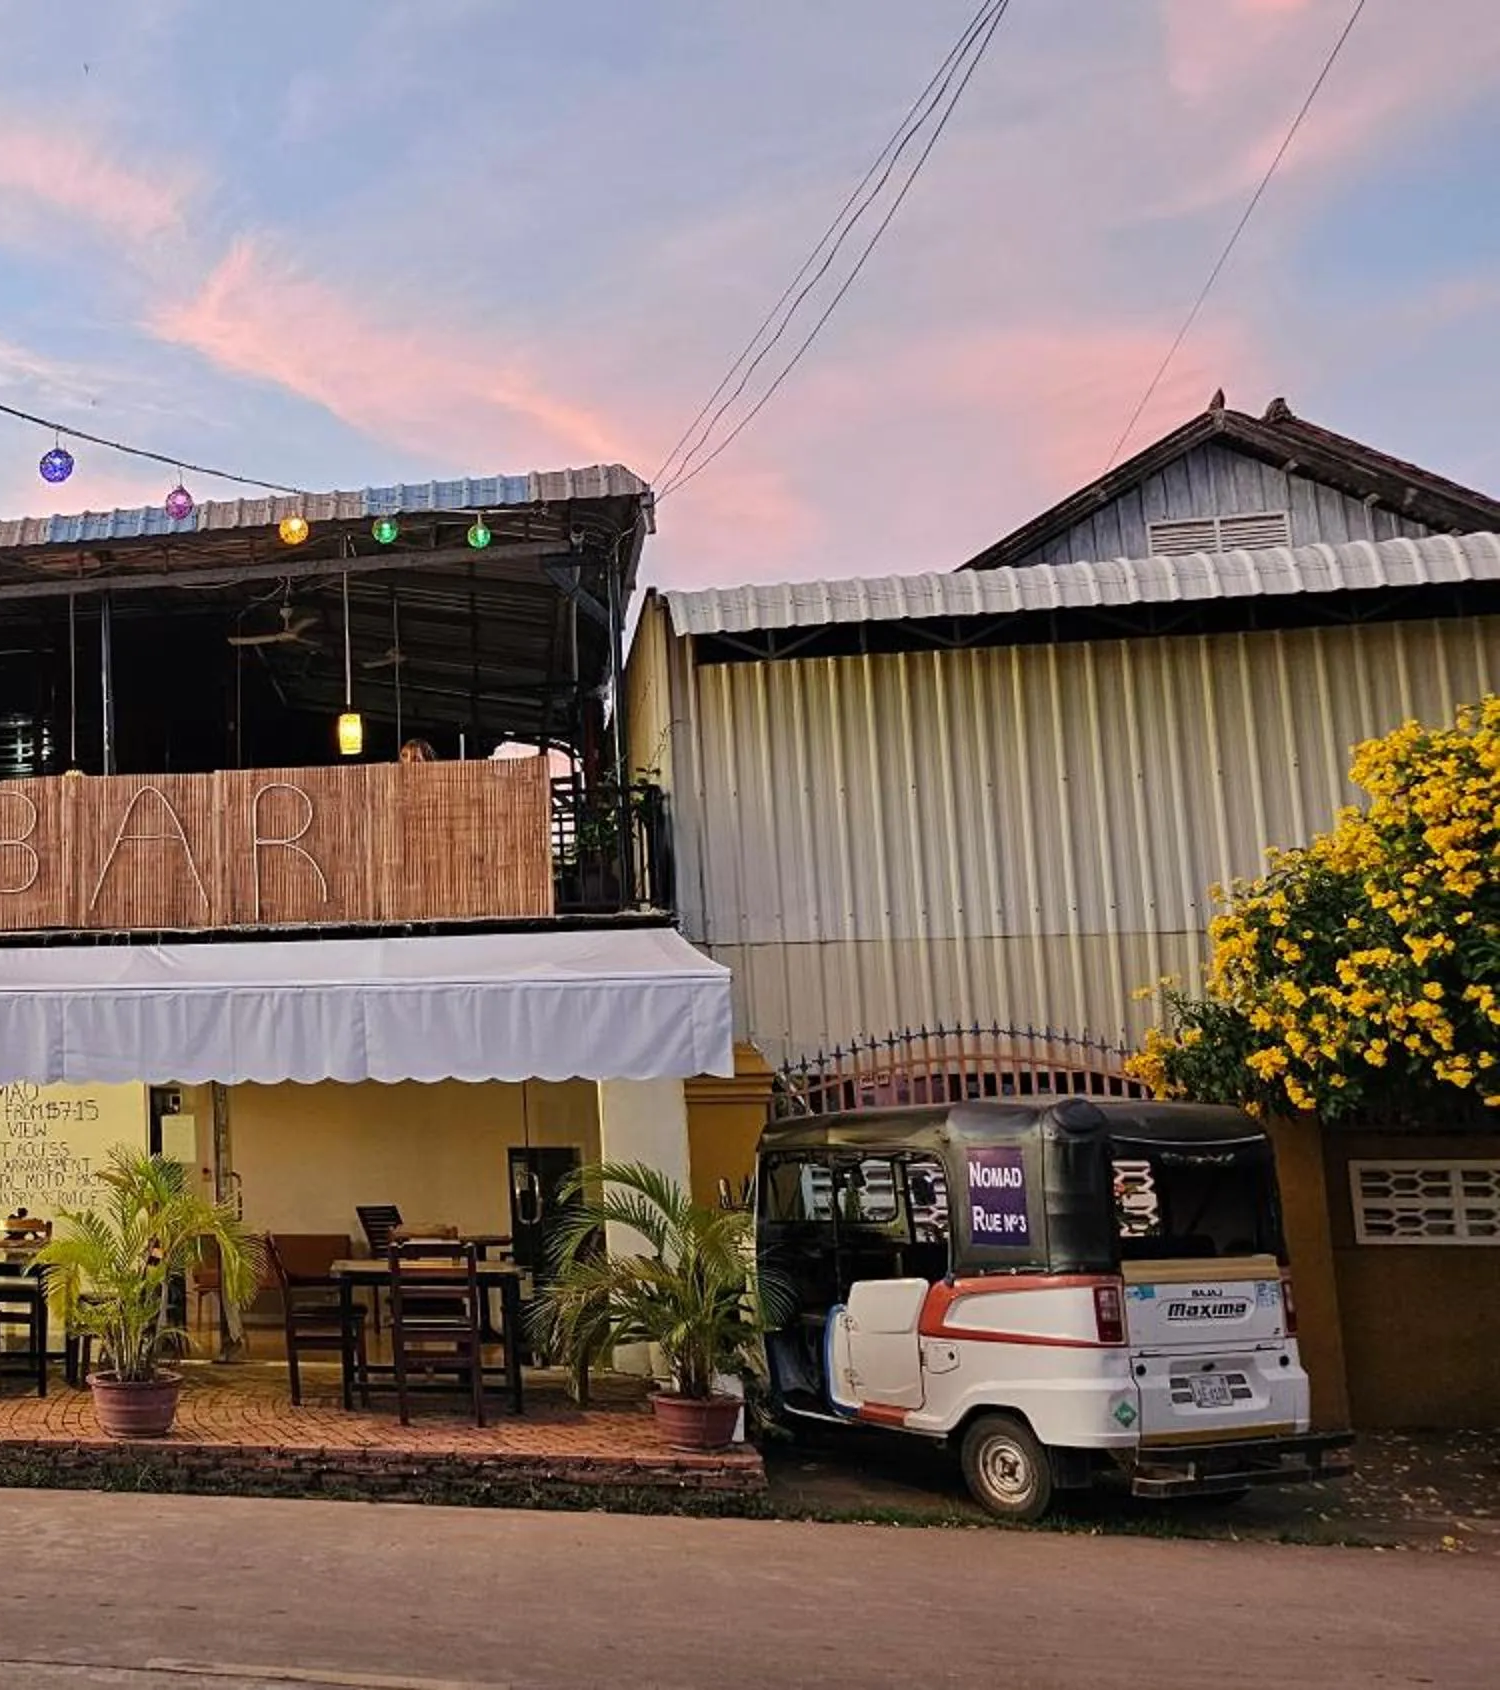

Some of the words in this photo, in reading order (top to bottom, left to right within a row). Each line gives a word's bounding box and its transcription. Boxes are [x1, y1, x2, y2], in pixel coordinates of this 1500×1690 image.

[5, 1104, 44, 1120] FROM
[7, 1121, 47, 1138] VIEW
[968, 1161, 1023, 1188] NOMAD
[972, 1205, 1002, 1232] RUE
